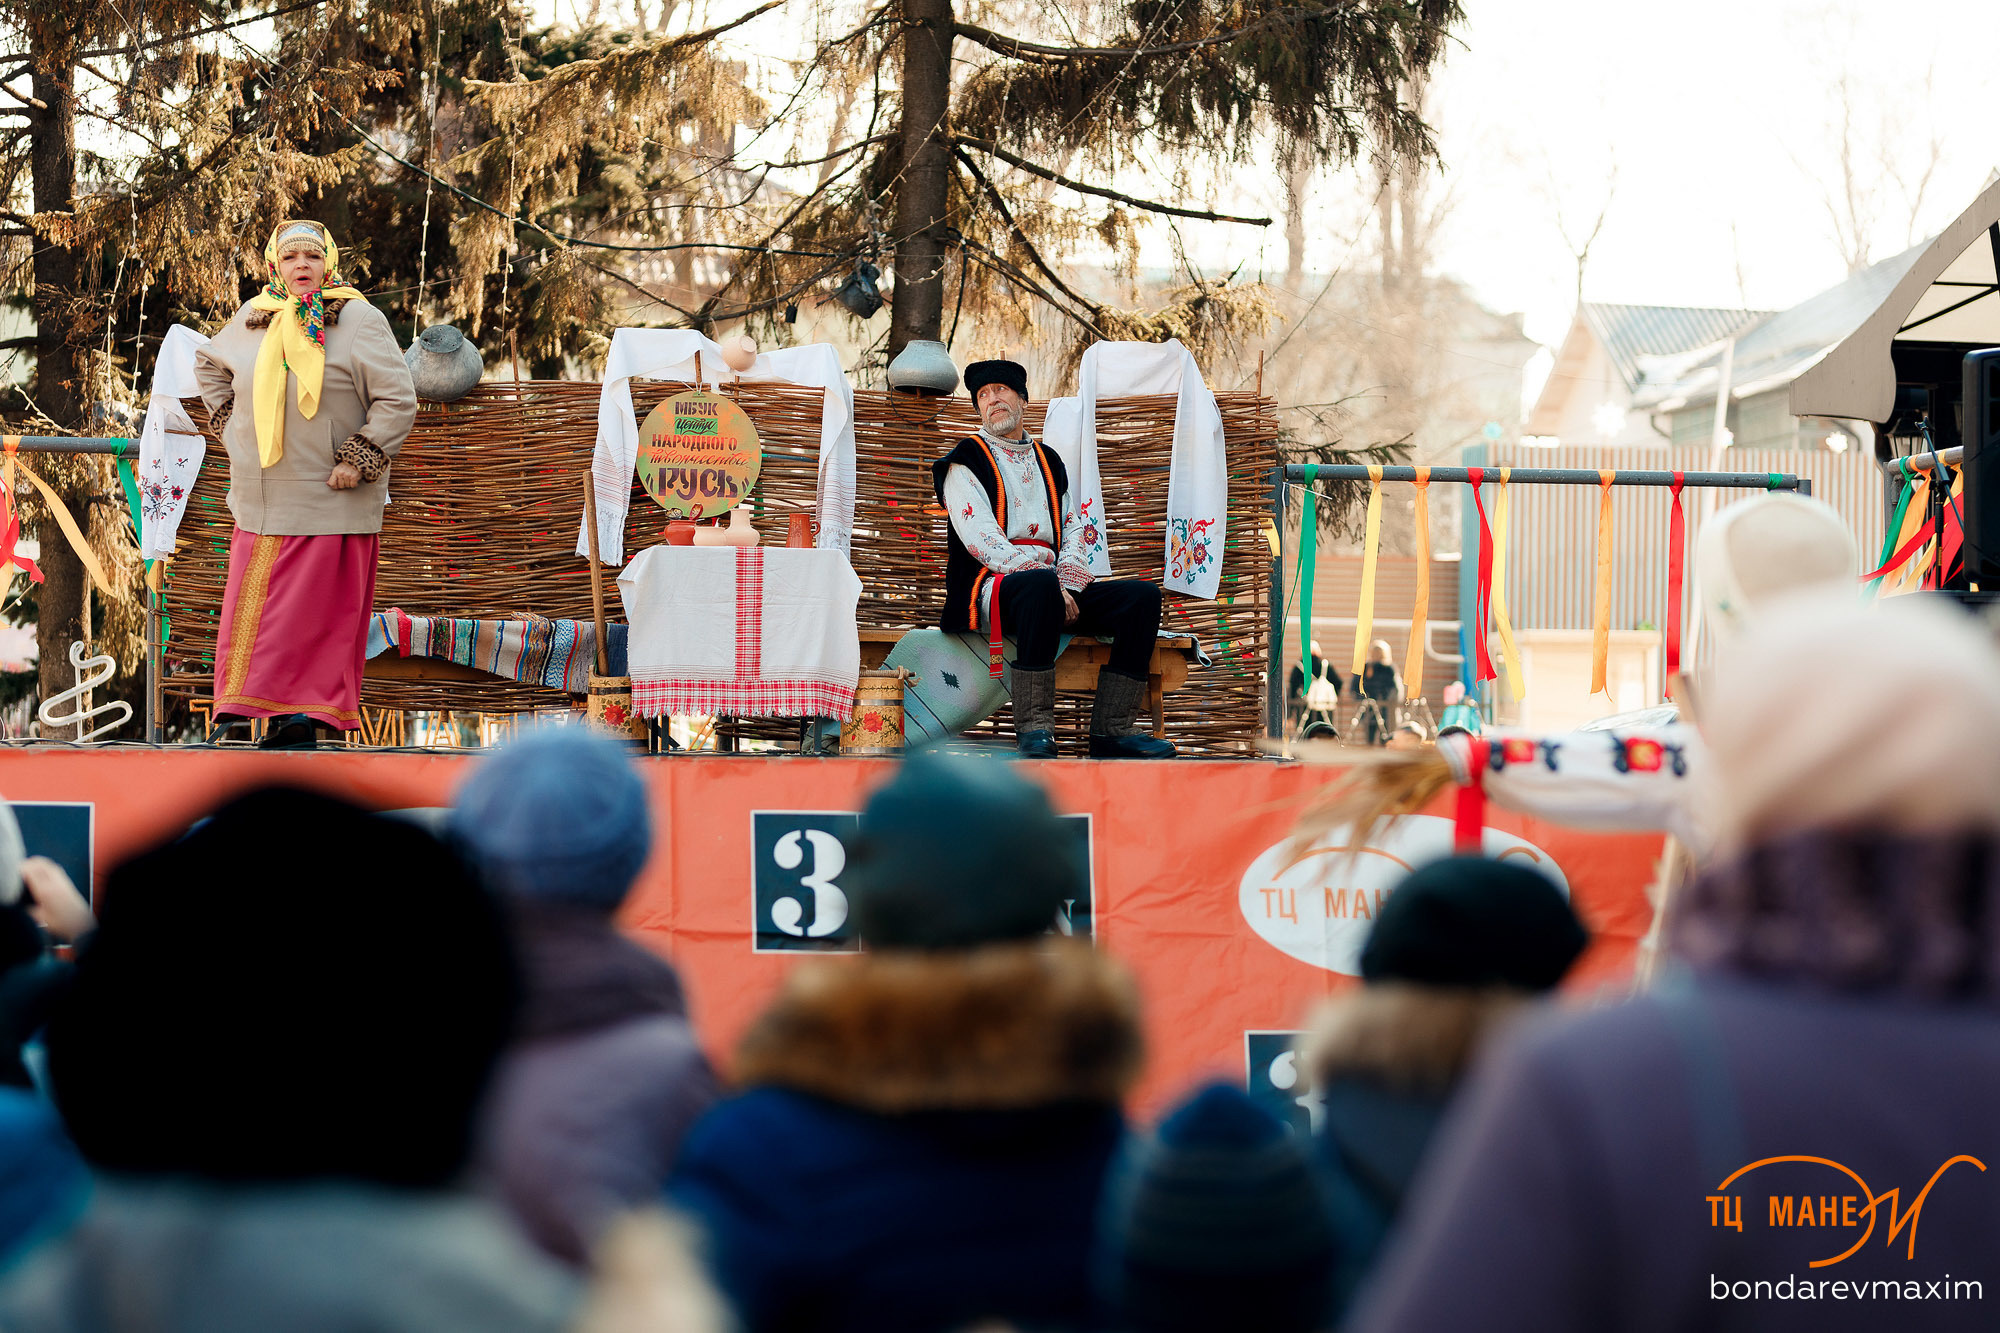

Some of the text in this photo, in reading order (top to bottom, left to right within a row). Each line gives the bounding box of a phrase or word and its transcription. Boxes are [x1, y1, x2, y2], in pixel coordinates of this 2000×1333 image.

[674, 401, 718, 416] МБУК
[651, 434, 738, 452] НАРОДНОГО
[771, 828, 848, 937] 3
[1259, 887, 1298, 925] ТЦ
